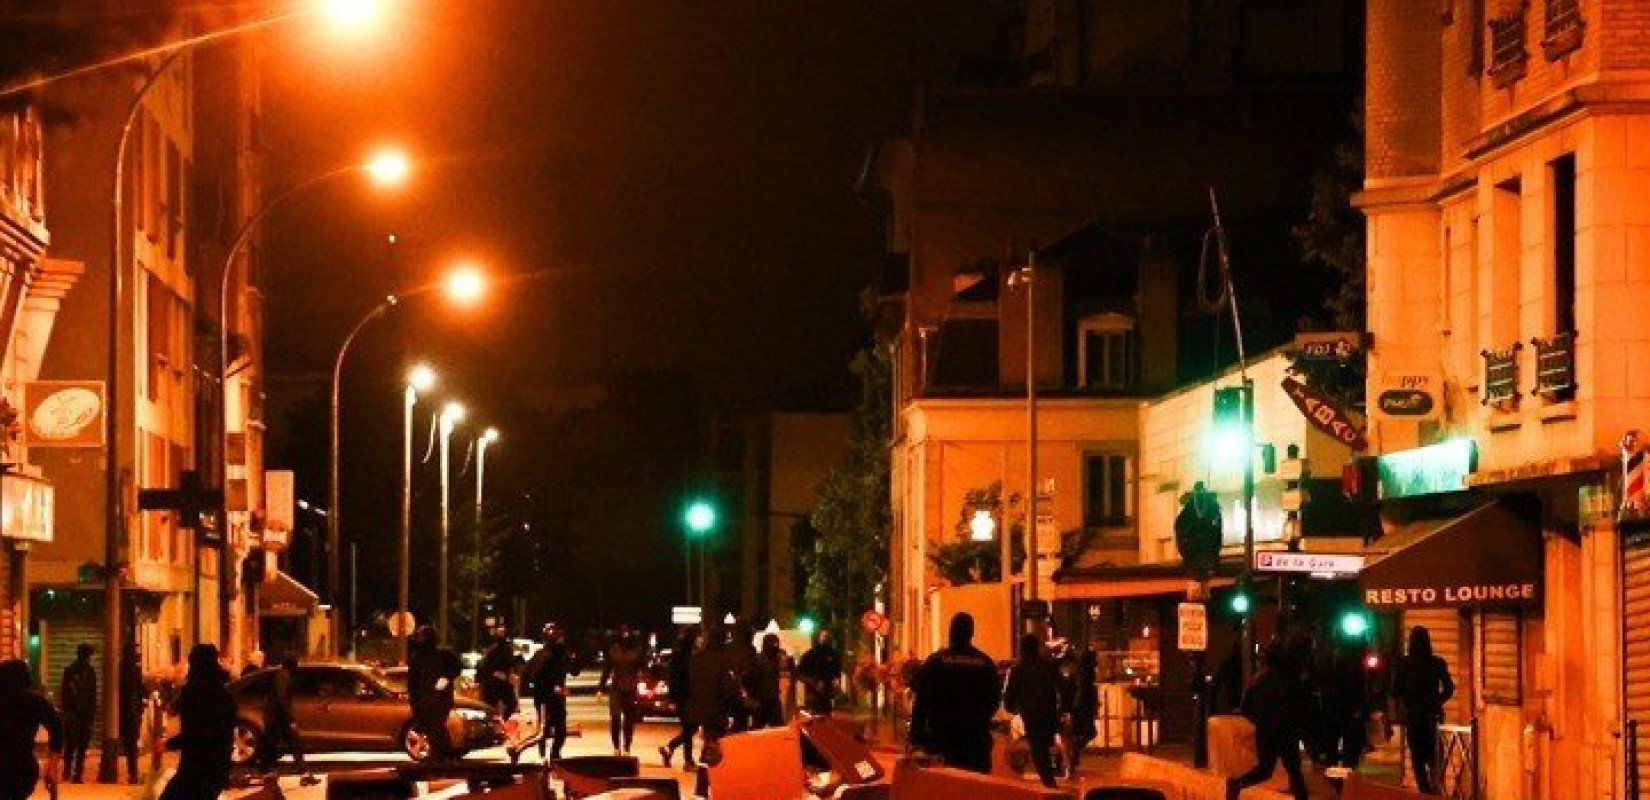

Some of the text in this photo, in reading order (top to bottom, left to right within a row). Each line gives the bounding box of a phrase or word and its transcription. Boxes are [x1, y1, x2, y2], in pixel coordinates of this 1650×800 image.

[1292, 385, 1356, 442] TABAC
[1365, 583, 1534, 604] RESTO LOUNGE
